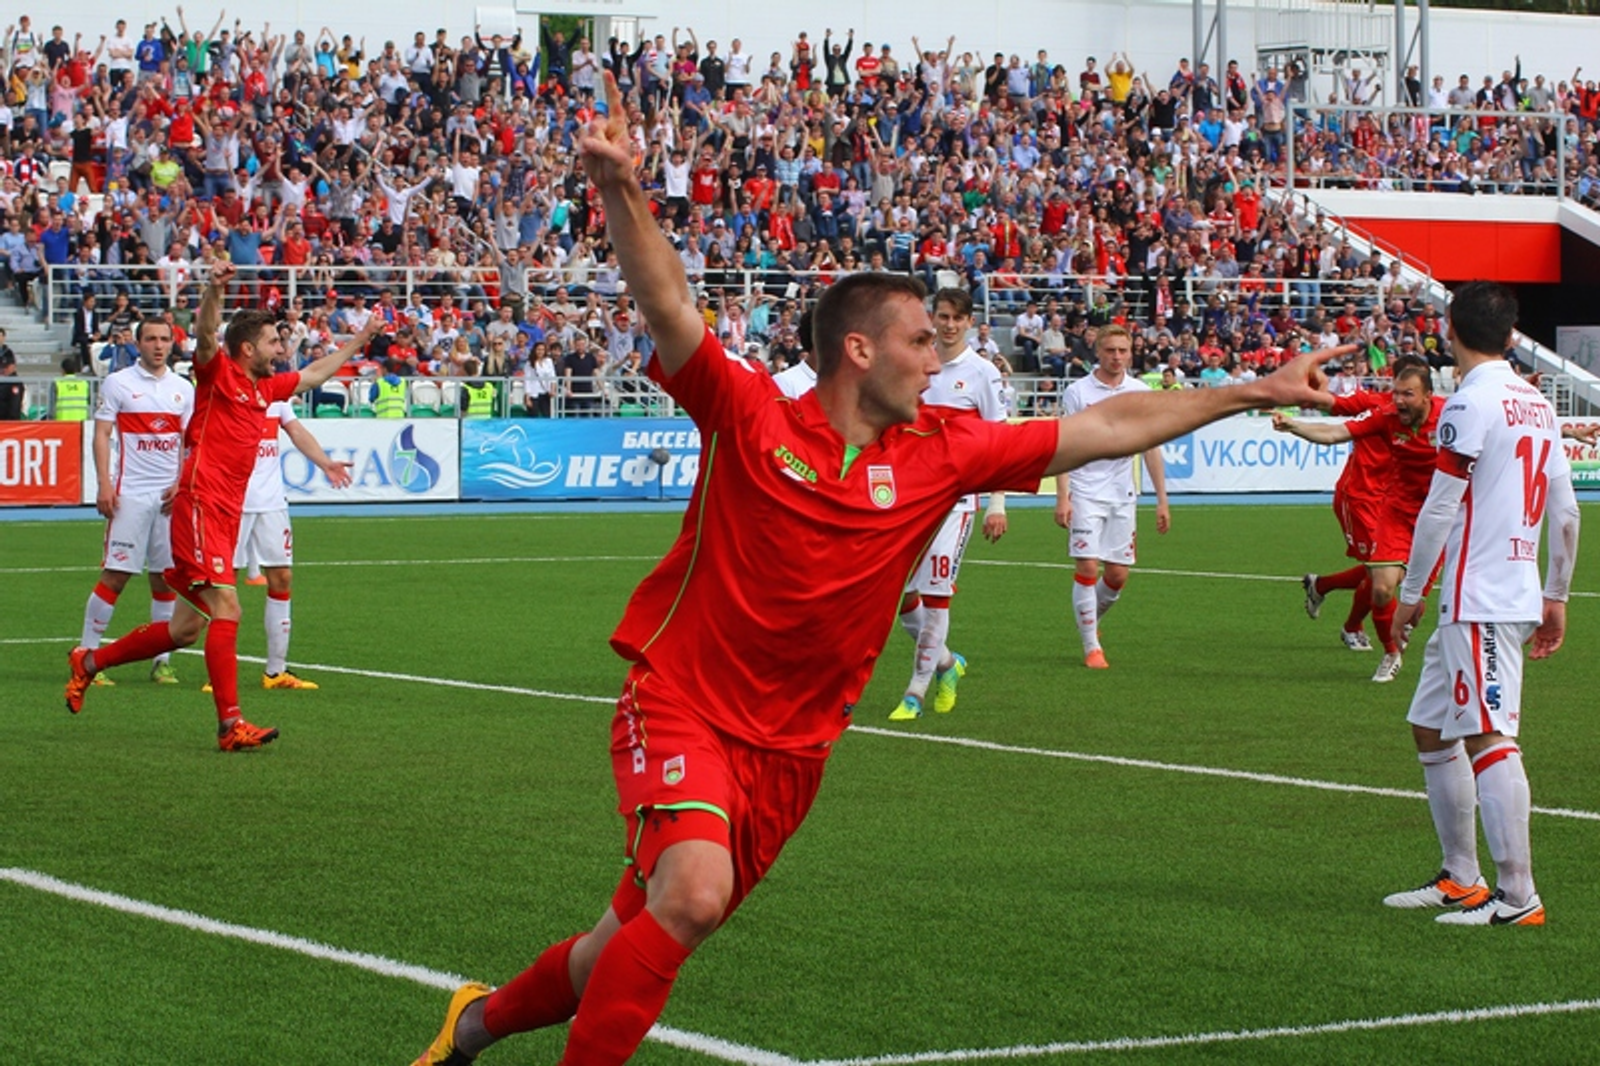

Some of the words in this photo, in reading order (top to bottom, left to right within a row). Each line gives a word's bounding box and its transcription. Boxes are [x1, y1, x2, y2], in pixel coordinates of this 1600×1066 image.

[0, 438, 62, 486] ORT
[1515, 435, 1552, 527] 16
[930, 555, 950, 579] 18
[1454, 669, 1470, 707] 6
